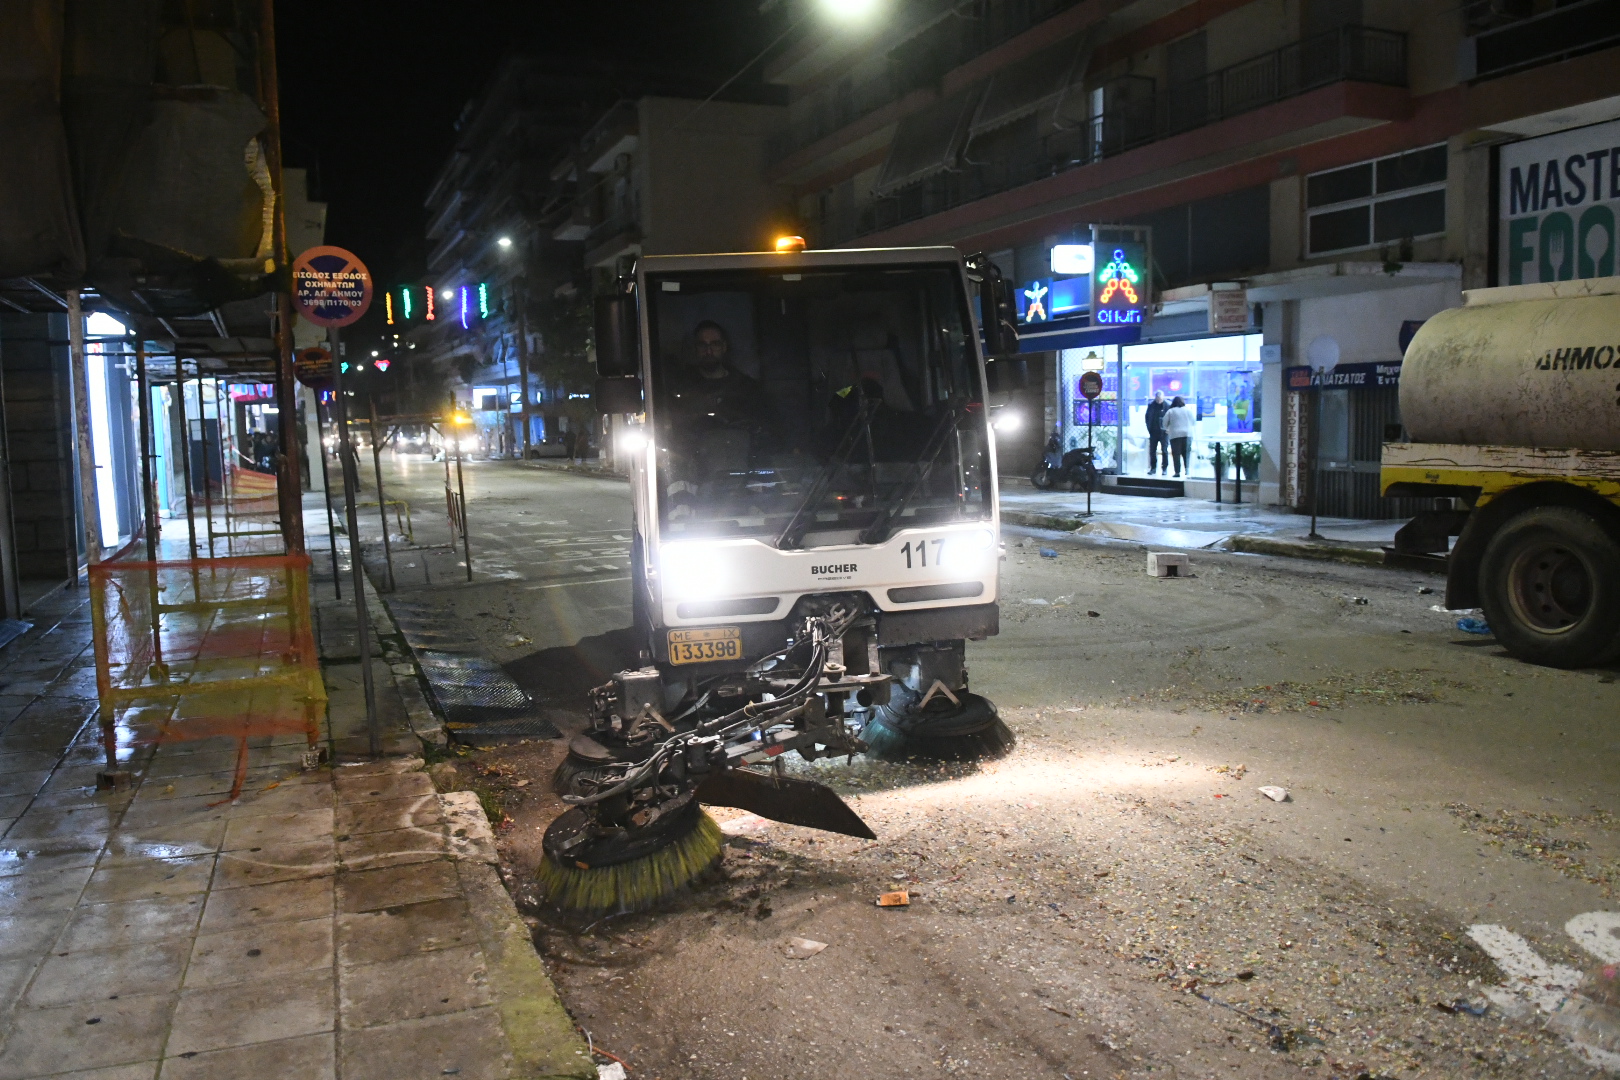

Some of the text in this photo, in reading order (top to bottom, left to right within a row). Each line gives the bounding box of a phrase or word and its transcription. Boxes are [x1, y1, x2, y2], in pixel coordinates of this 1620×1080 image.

[292, 271, 367, 280] ΕΙΣΟΔΟΣ ΕΞΟΔΟΣ
[304, 281, 355, 289] ΟΧΗΜΑΤΩΝ
[298, 289, 312, 297] ΑΡ.
[331, 290, 363, 298] ΔΗΜΟΥ
[900, 538, 946, 569] 117
[811, 563, 858, 575] BUCHER
[673, 640, 737, 661] 133398
